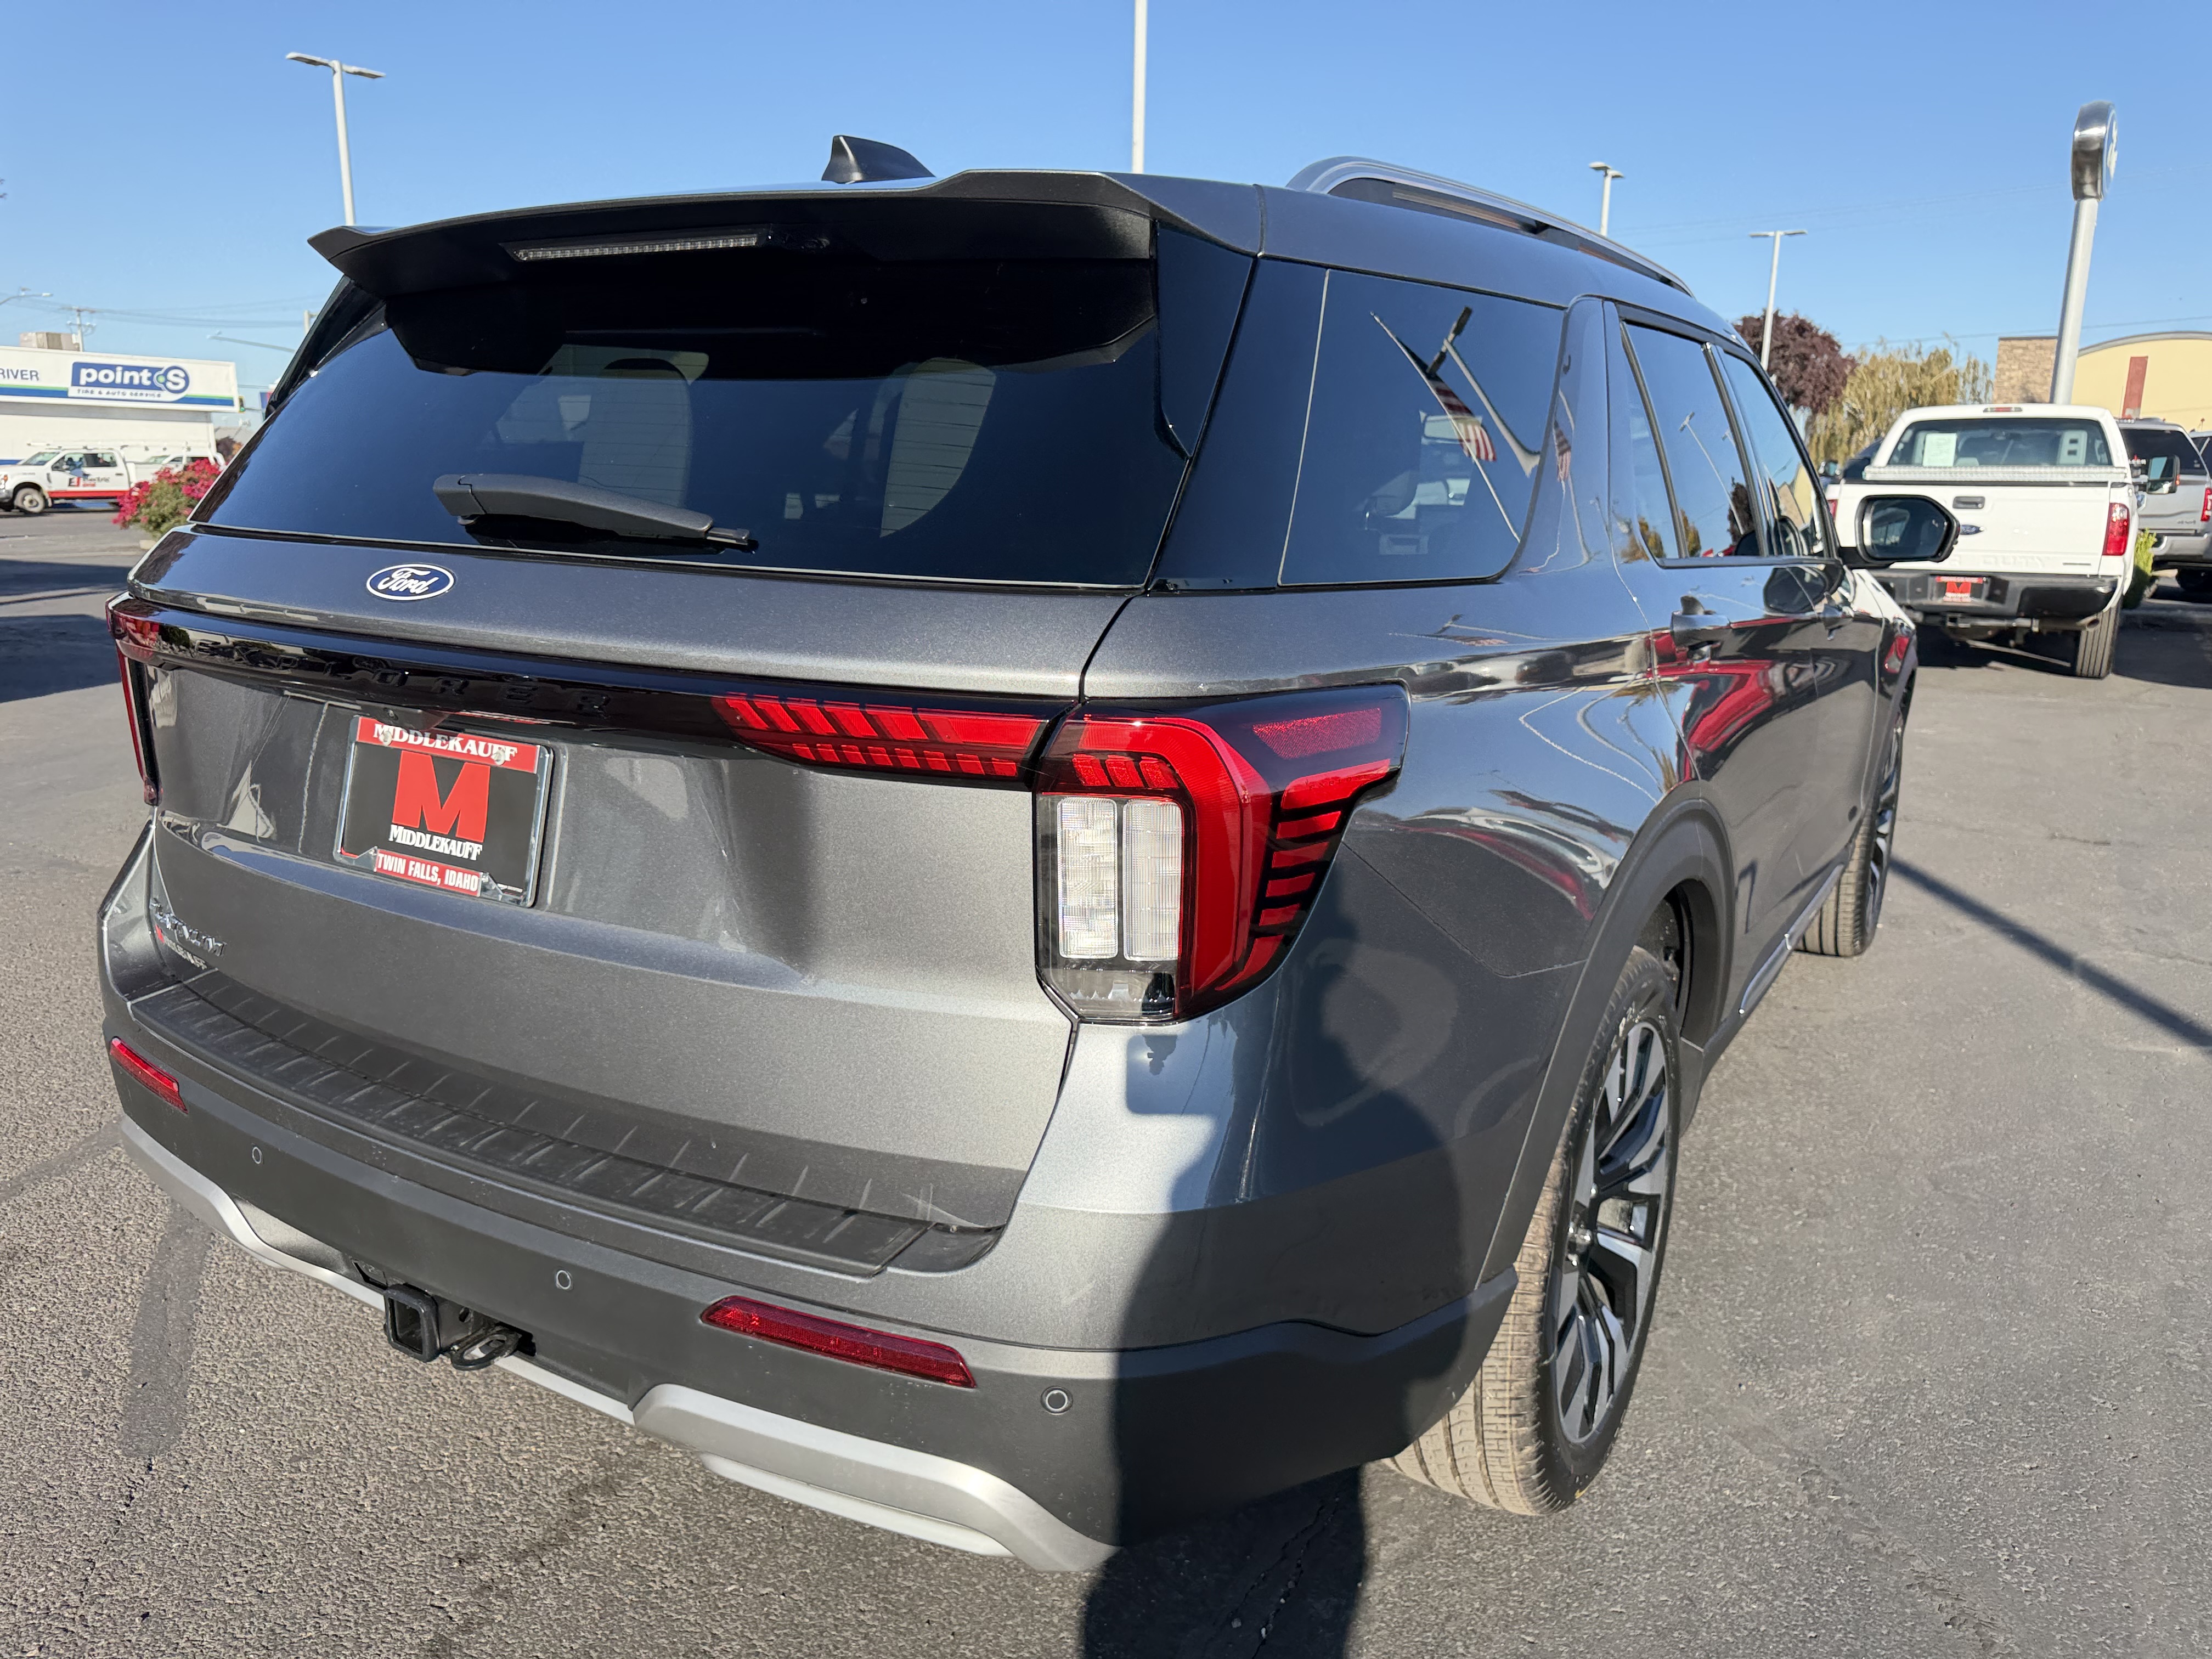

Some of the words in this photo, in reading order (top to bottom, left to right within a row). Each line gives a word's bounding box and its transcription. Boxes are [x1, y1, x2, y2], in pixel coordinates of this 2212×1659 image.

[80, 366, 152, 386] point
[166, 369, 185, 390] S
[377, 568, 439, 594] Ford
[373, 723, 517, 761] MIDDLEKAUFF
[392, 750, 490, 843] M
[388, 824, 483, 861] MIDDLEKAUFF
[377, 853, 407, 874] TWIN
[408, 859, 441, 885] FALLS,
[444, 868, 478, 891] IDAHO
